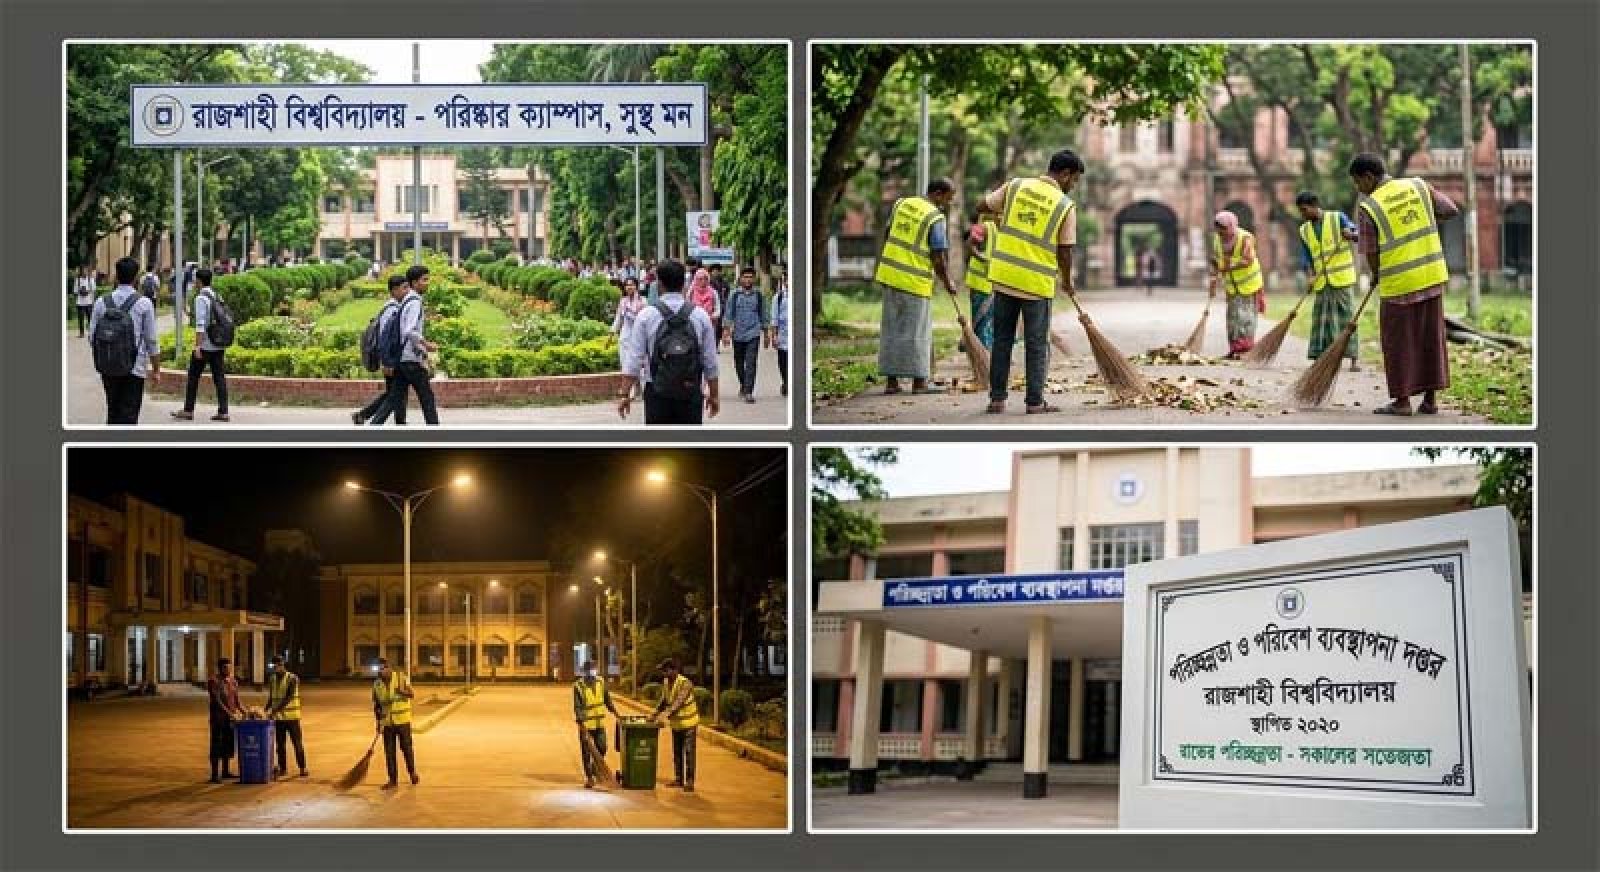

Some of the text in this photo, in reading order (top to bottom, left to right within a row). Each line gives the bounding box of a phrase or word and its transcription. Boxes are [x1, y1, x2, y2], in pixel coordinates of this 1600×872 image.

[191, 93, 278, 132] রাজশাহী
[285, 94, 408, 131] বিশ্ববিদ্যালয়
[433, 93, 510, 128] পরিষ্কার
[516, 100, 611, 134] ক্যাম্পাস,
[618, 103, 656, 136] সুস্থ
[660, 103, 694, 128] মন
[1236, 637, 1250, 657] ও
[1253, 622, 1311, 655] পরিবেশ
[1315, 627, 1400, 662] ব্যবস্থাপনা
[1403, 641, 1447, 680] দপ্তর
[1201, 675, 1397, 706] রাজশাহী বিশ্ববিদ্যালয়
[1250, 711, 1339, 736] স্থাপিত ২০২০
